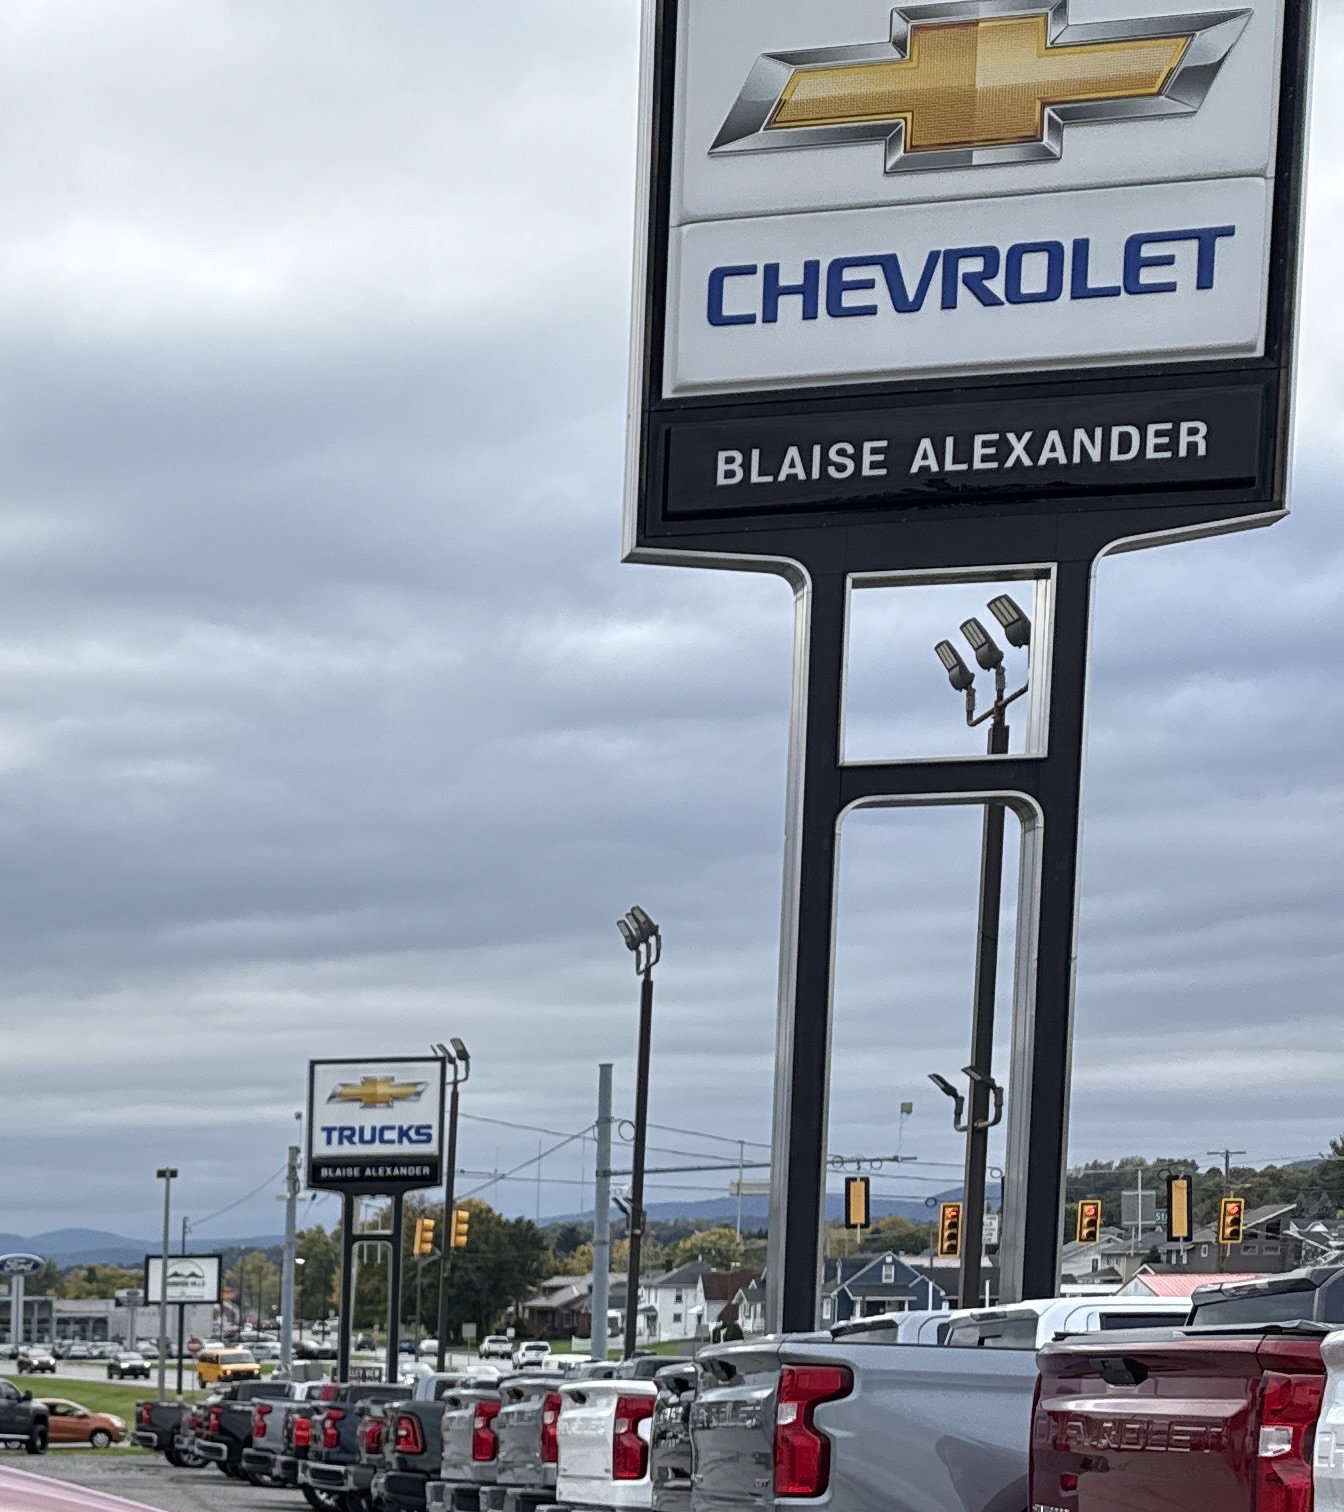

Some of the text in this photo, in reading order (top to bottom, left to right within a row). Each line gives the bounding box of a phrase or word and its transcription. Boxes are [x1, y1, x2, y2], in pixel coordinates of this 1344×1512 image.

[707, 225, 1235, 326] CHEVROLET
[715, 420, 1209, 487] BLAISE ALEXANDER
[320, 1124, 432, 1146] TRUCKS
[320, 1165, 431, 1178] BLAISE ALEXANDER
